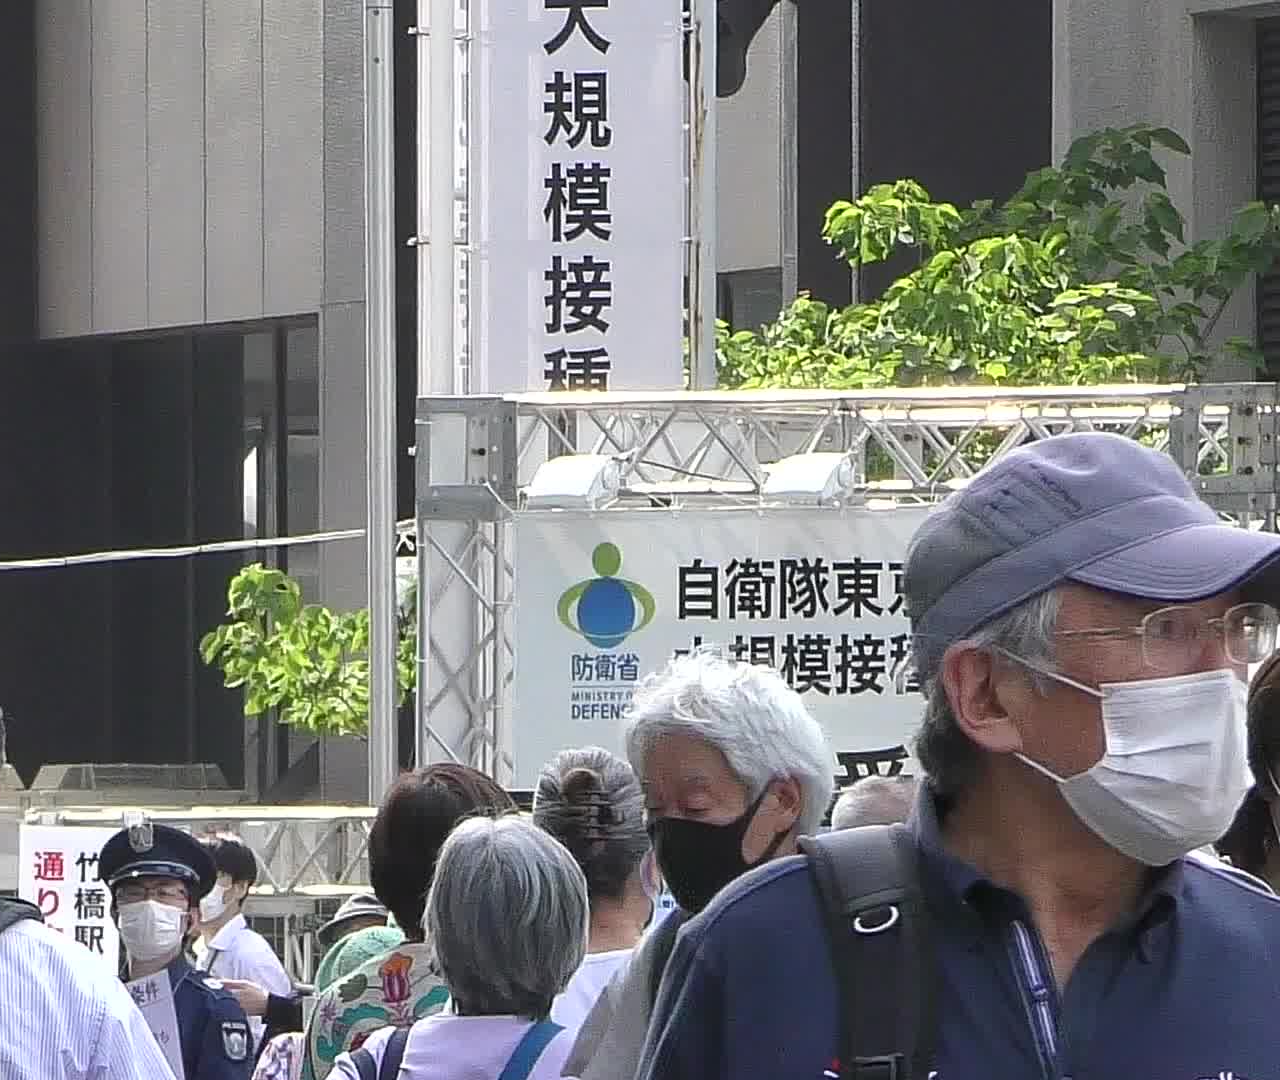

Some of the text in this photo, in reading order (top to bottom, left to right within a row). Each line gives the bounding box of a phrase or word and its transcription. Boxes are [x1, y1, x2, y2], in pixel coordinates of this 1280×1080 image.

[571, 653, 640, 681] 防衛省
[571, 691, 624, 701] MINISTRY
[571, 703, 626, 719] DEFEN
[33, 851, 64, 934] 通り
[74, 851, 105, 955] 竹橋駅
